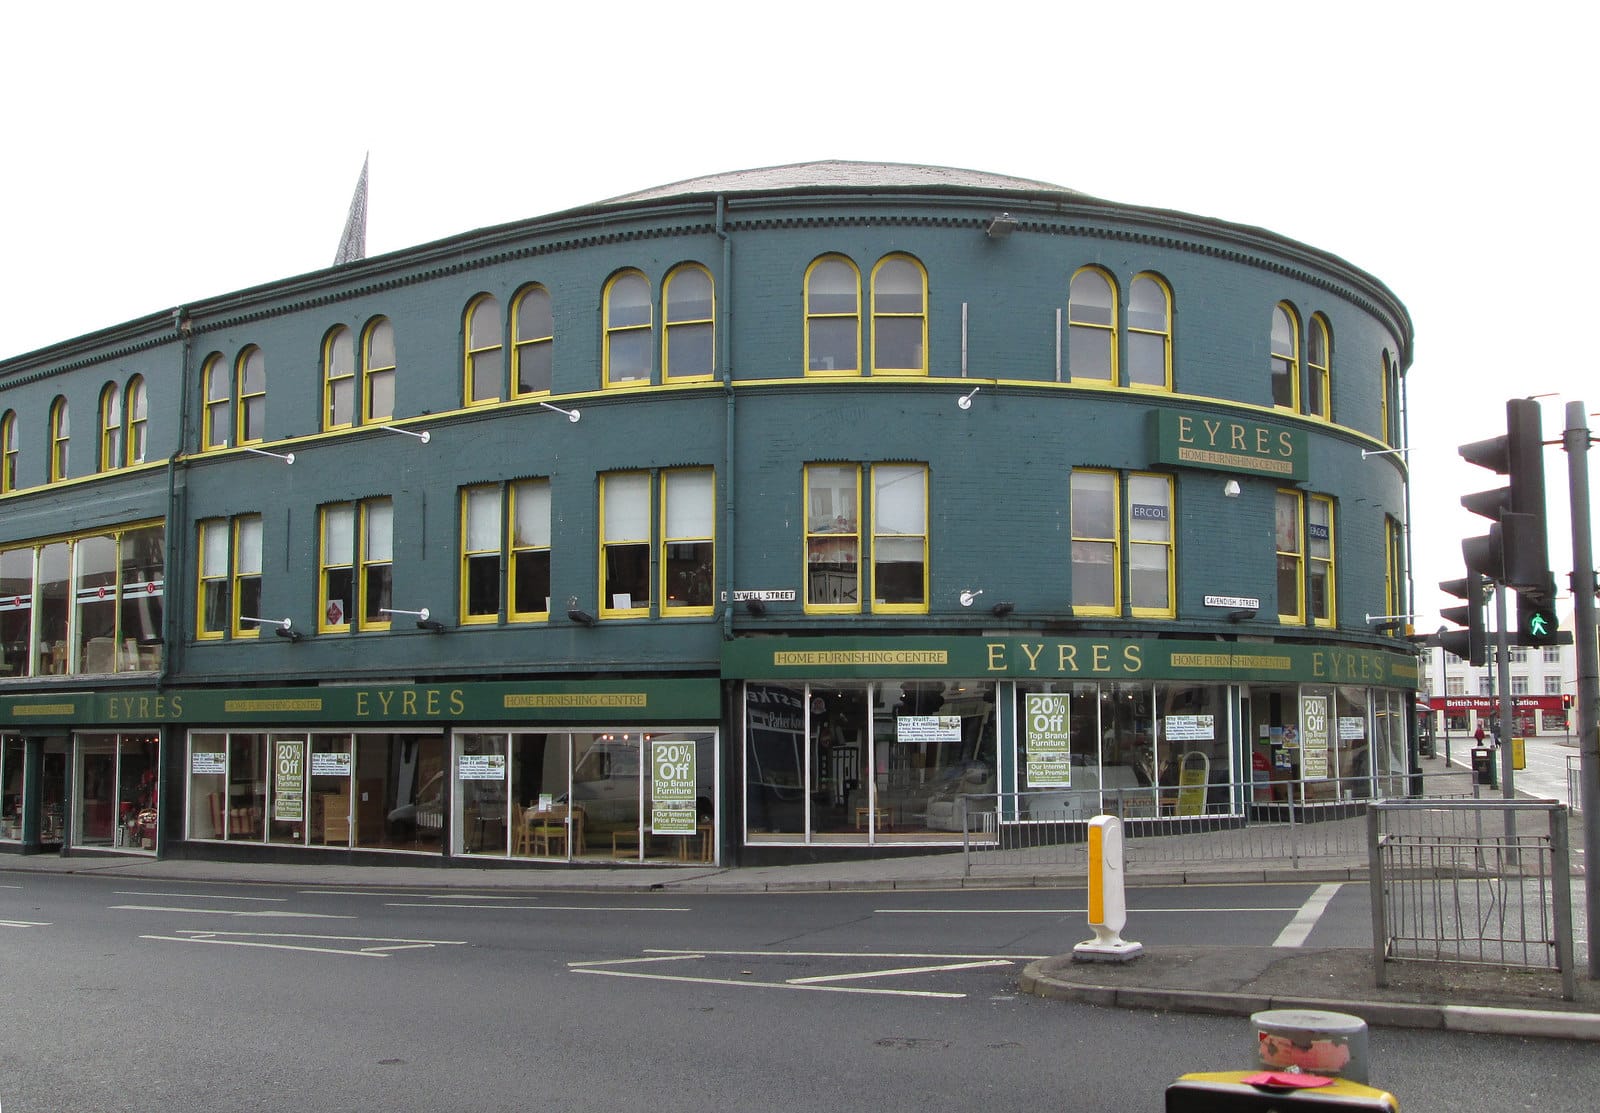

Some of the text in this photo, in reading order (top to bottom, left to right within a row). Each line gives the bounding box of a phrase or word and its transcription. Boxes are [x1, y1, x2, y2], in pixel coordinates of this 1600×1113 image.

[1178, 416, 1293, 457] EYRES
[1181, 448, 1207, 461] HOME
[1208, 452, 1259, 468] FURNISHING
[1134, 507, 1165, 518] ERCOL
[722, 591, 794, 600] HLYWELL STREET
[1206, 597, 1258, 607] CAVENDISH STREET
[777, 651, 945, 664] HOME FURNISHING CENTRE
[987, 643, 1142, 672] EYRES
[1173, 655, 1202, 665] HOME
[1312, 652, 1385, 680] EYRES
[109, 696, 183, 719] EYRES
[356, 689, 465, 716] EYRES
[506, 694, 644, 706] HOME FURNISHING CENTRE
[1031, 697, 1065, 714] 20%
[1305, 700, 1325, 715] 20%
[1446, 699, 1472, 707] British
[1034, 715, 1063, 732] Off
[1307, 715, 1324, 731] Off
[1029, 732, 1043, 740] Top
[1031, 739, 1066, 747] Furniture
[279, 744, 300, 760] 20%
[656, 745, 691, 762] 20%
[280, 759, 299, 774] Off
[659, 763, 689, 780] Off
[655, 779, 693, 788] Top Brand
[656, 787, 692, 795] Furniture
